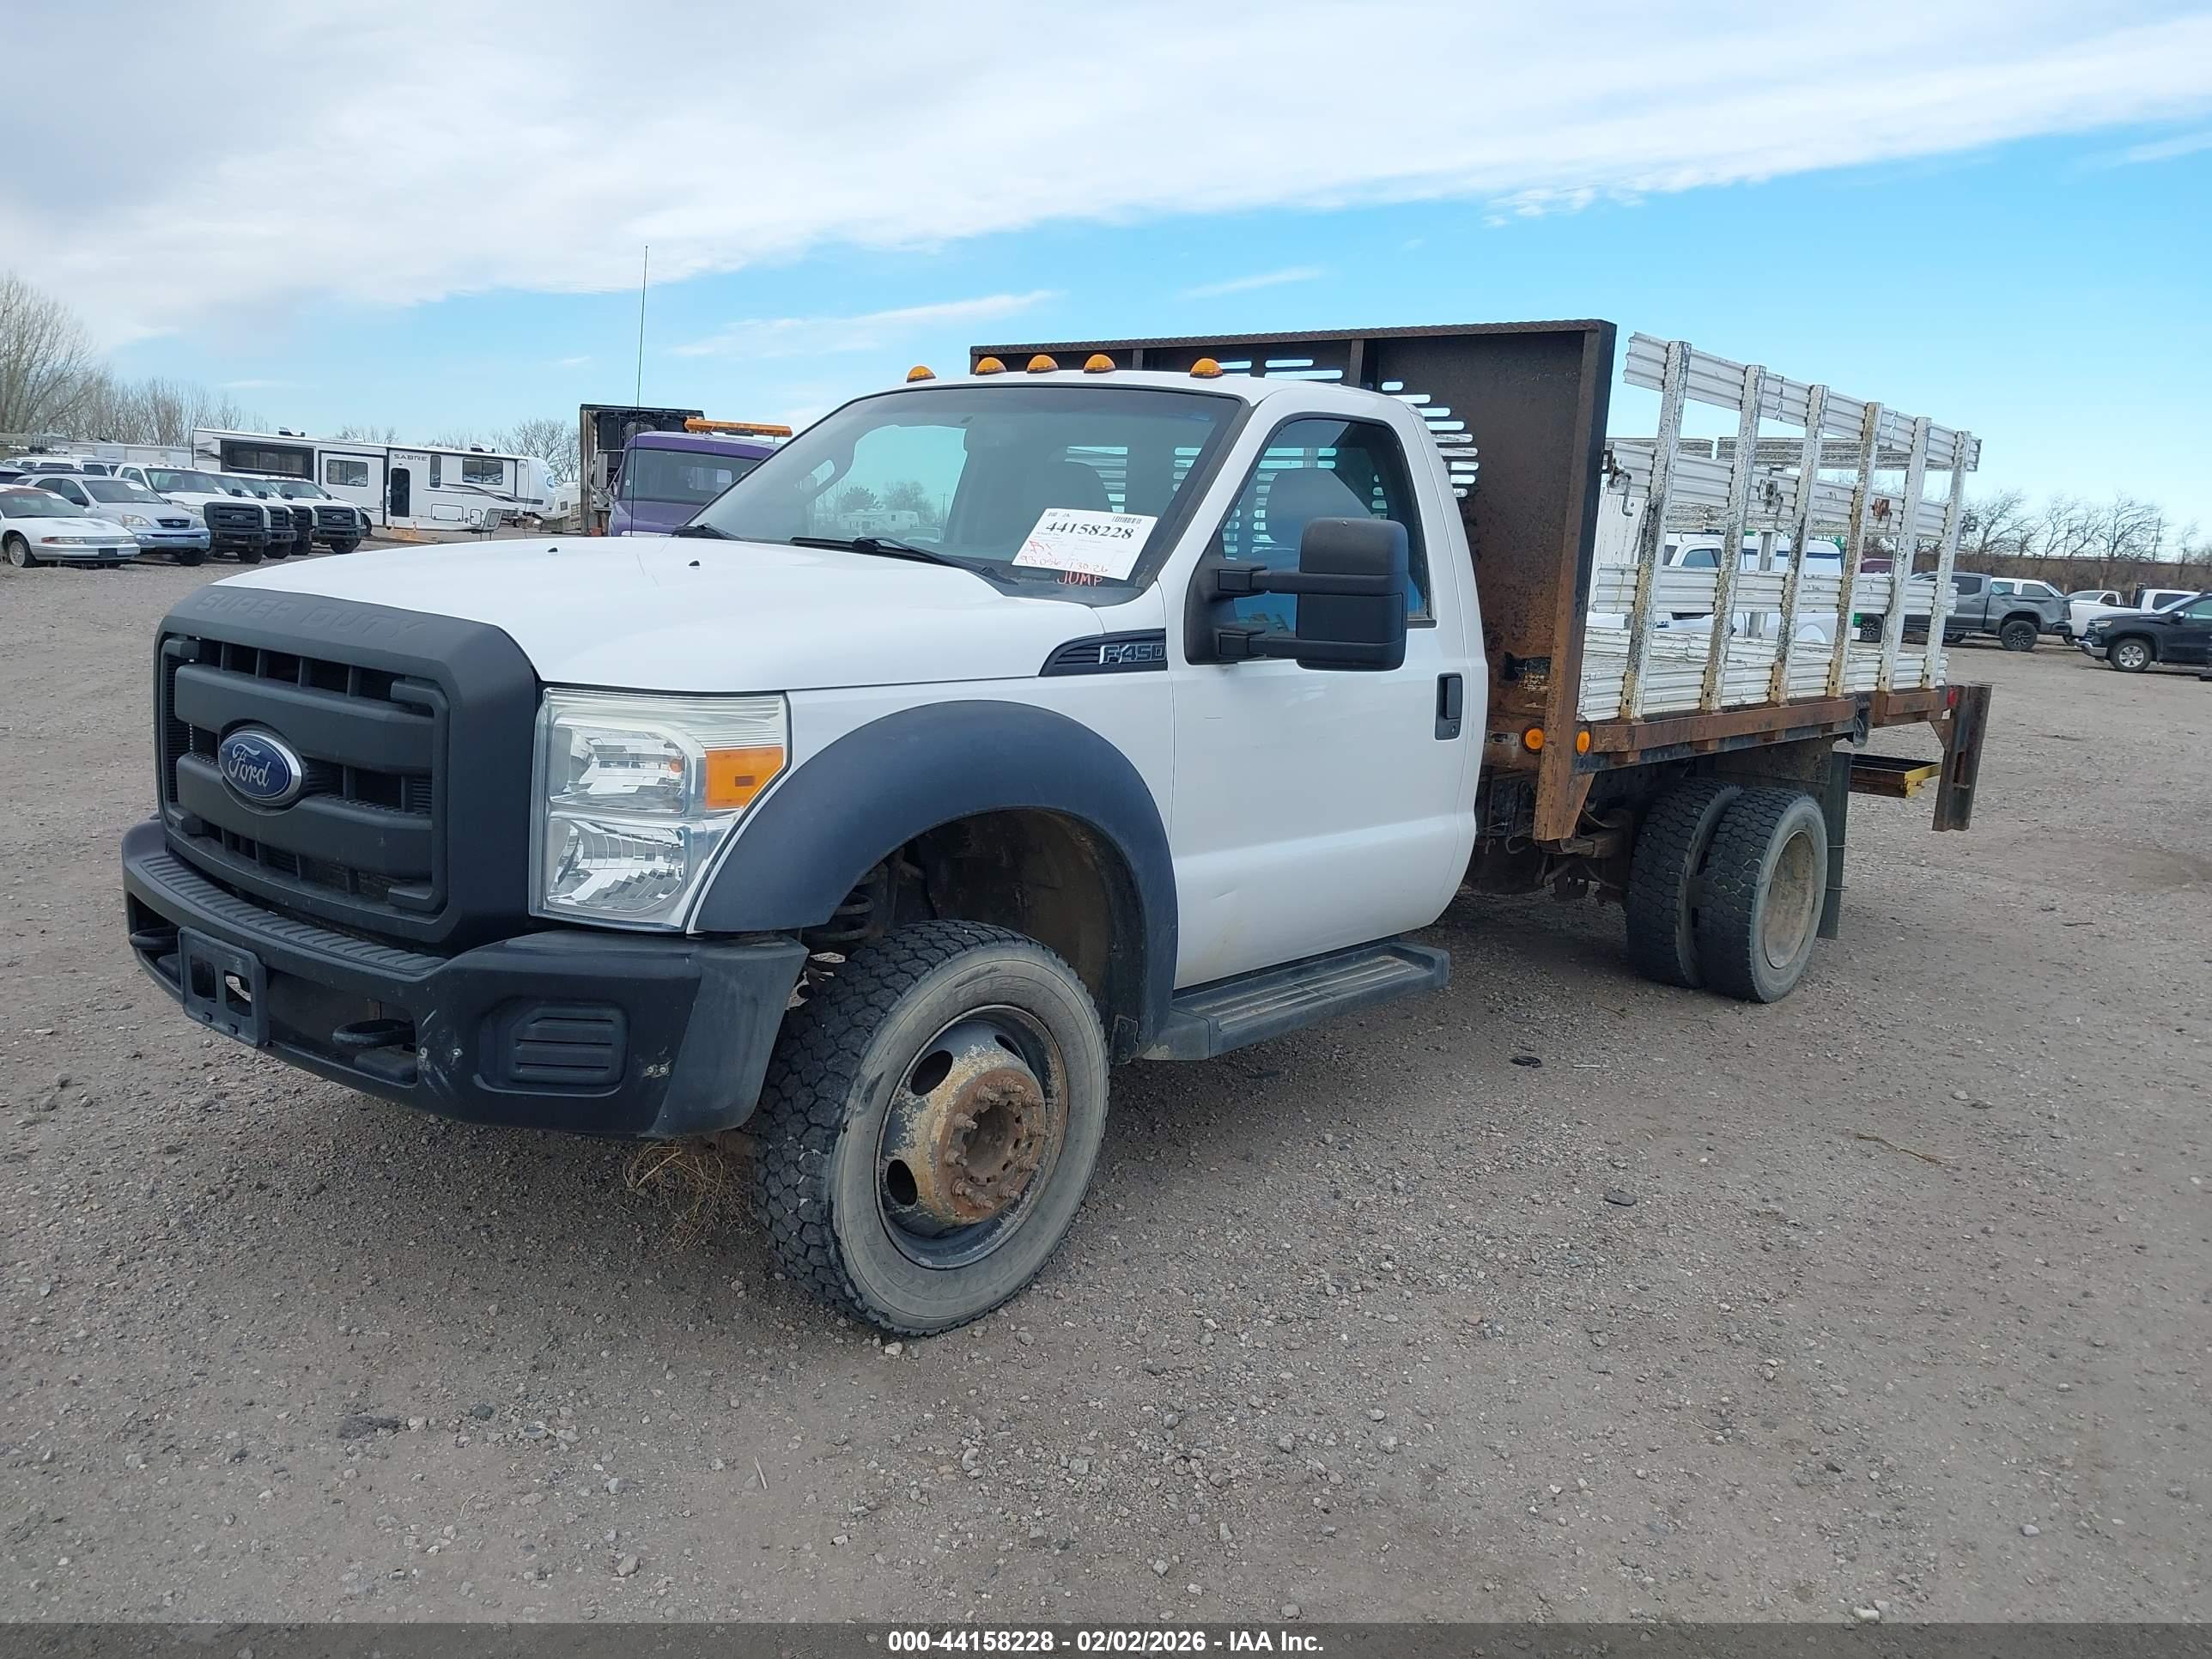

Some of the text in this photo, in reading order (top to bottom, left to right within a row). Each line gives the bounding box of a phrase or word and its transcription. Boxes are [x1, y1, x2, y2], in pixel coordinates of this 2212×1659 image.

[393, 453, 428, 462] SABRE
[1045, 521, 1134, 540] 44158228
[1056, 571, 1103, 586] JUMP
[194, 592, 428, 641] SUPER DUTY
[227, 742, 273, 790] Ford
